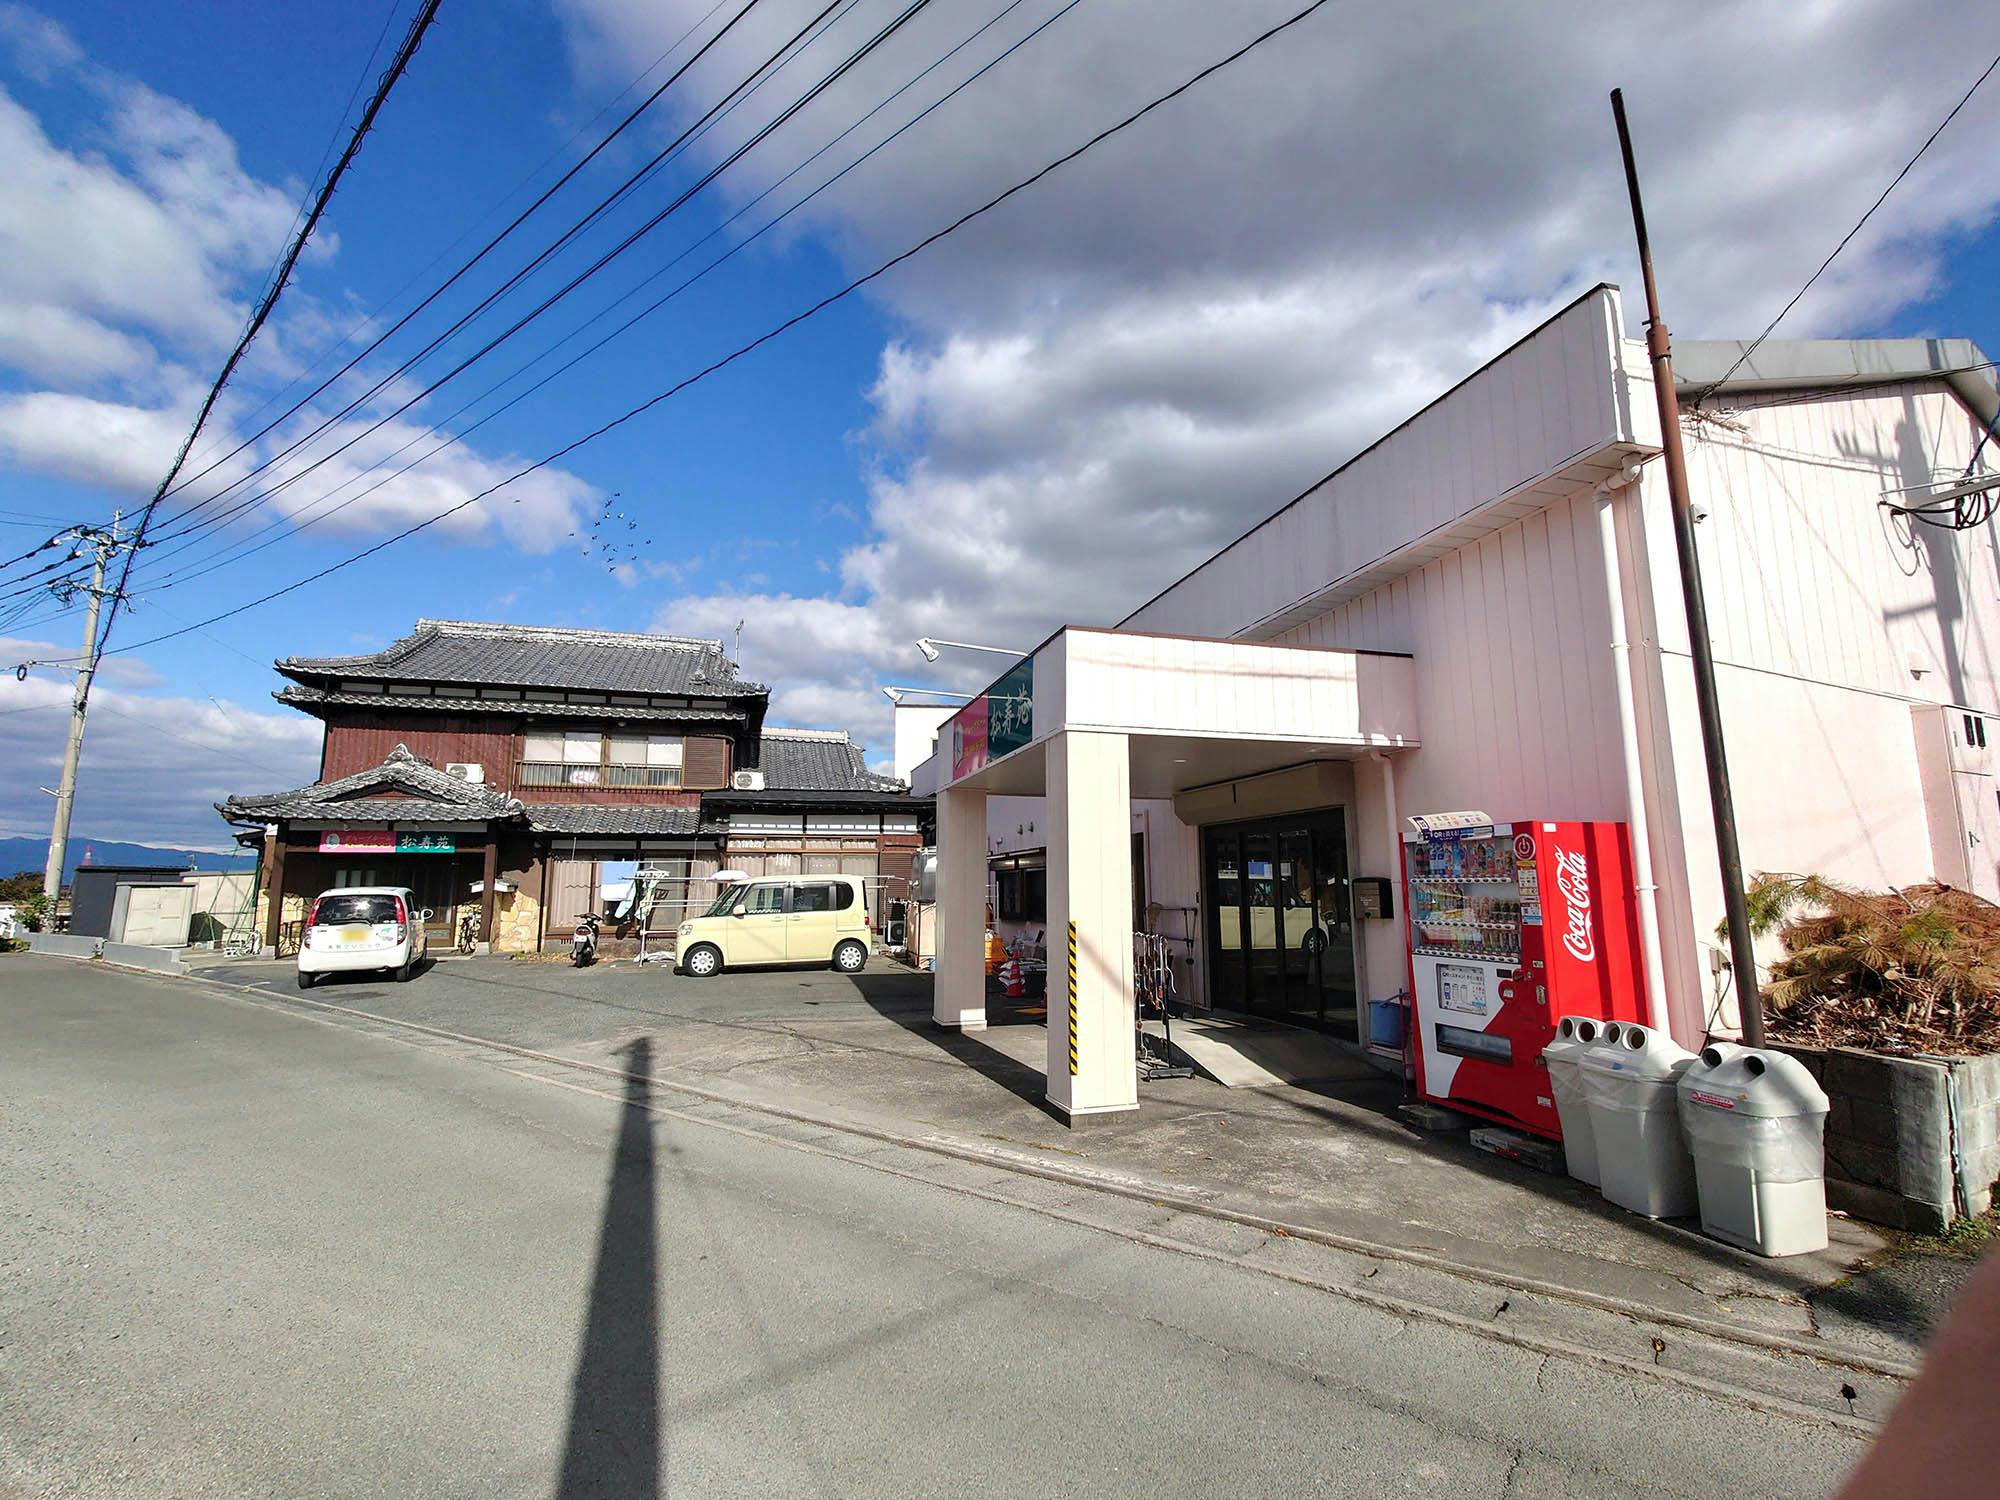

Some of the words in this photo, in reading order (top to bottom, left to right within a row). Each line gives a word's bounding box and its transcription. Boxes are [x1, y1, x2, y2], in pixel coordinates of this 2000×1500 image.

[990, 683, 1030, 743] 松寿苑
[401, 835, 450, 849] 松寿苑
[1554, 844, 1595, 962] Coca-Cola
